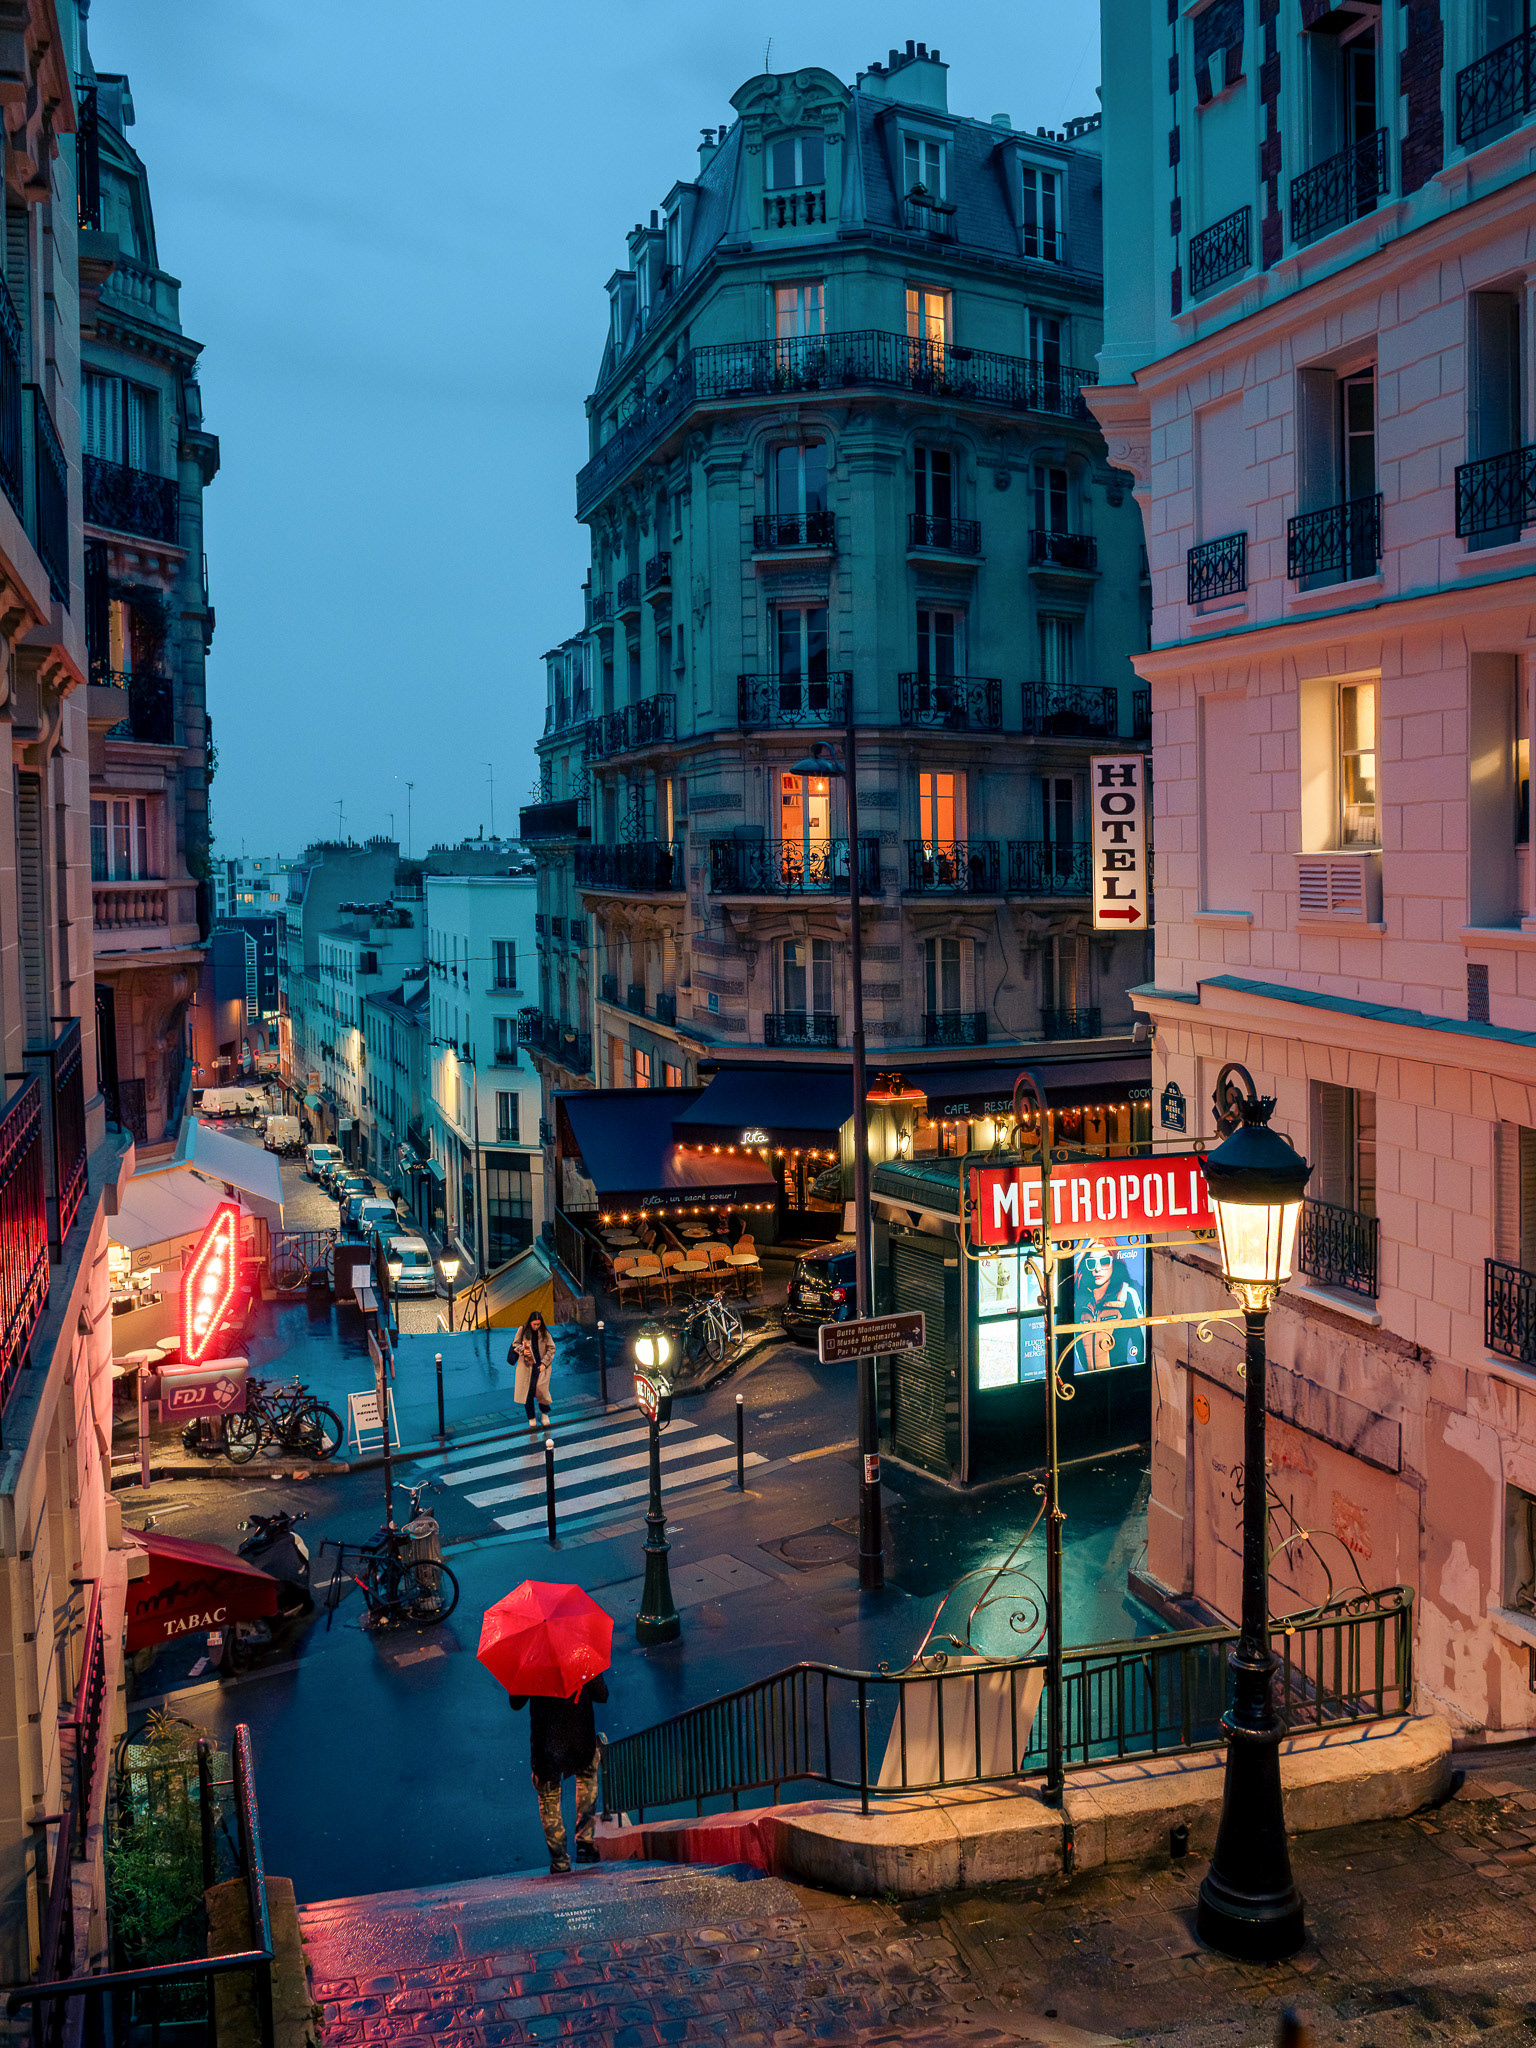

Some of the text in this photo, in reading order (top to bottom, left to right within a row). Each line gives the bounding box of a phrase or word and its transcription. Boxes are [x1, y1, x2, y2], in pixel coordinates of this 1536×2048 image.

[1097, 764, 1137, 900] HOTEL
[1128, 1088, 1152, 1099] COCK
[944, 1103, 970, 1115] CAFE
[741, 1131, 769, 1144] Rita
[858, 1323, 897, 1334] Montmartre
[861, 1331, 900, 1342] Montmartre
[173, 1388, 206, 1405] FDJ
[163, 1607, 227, 1635] TABAC
